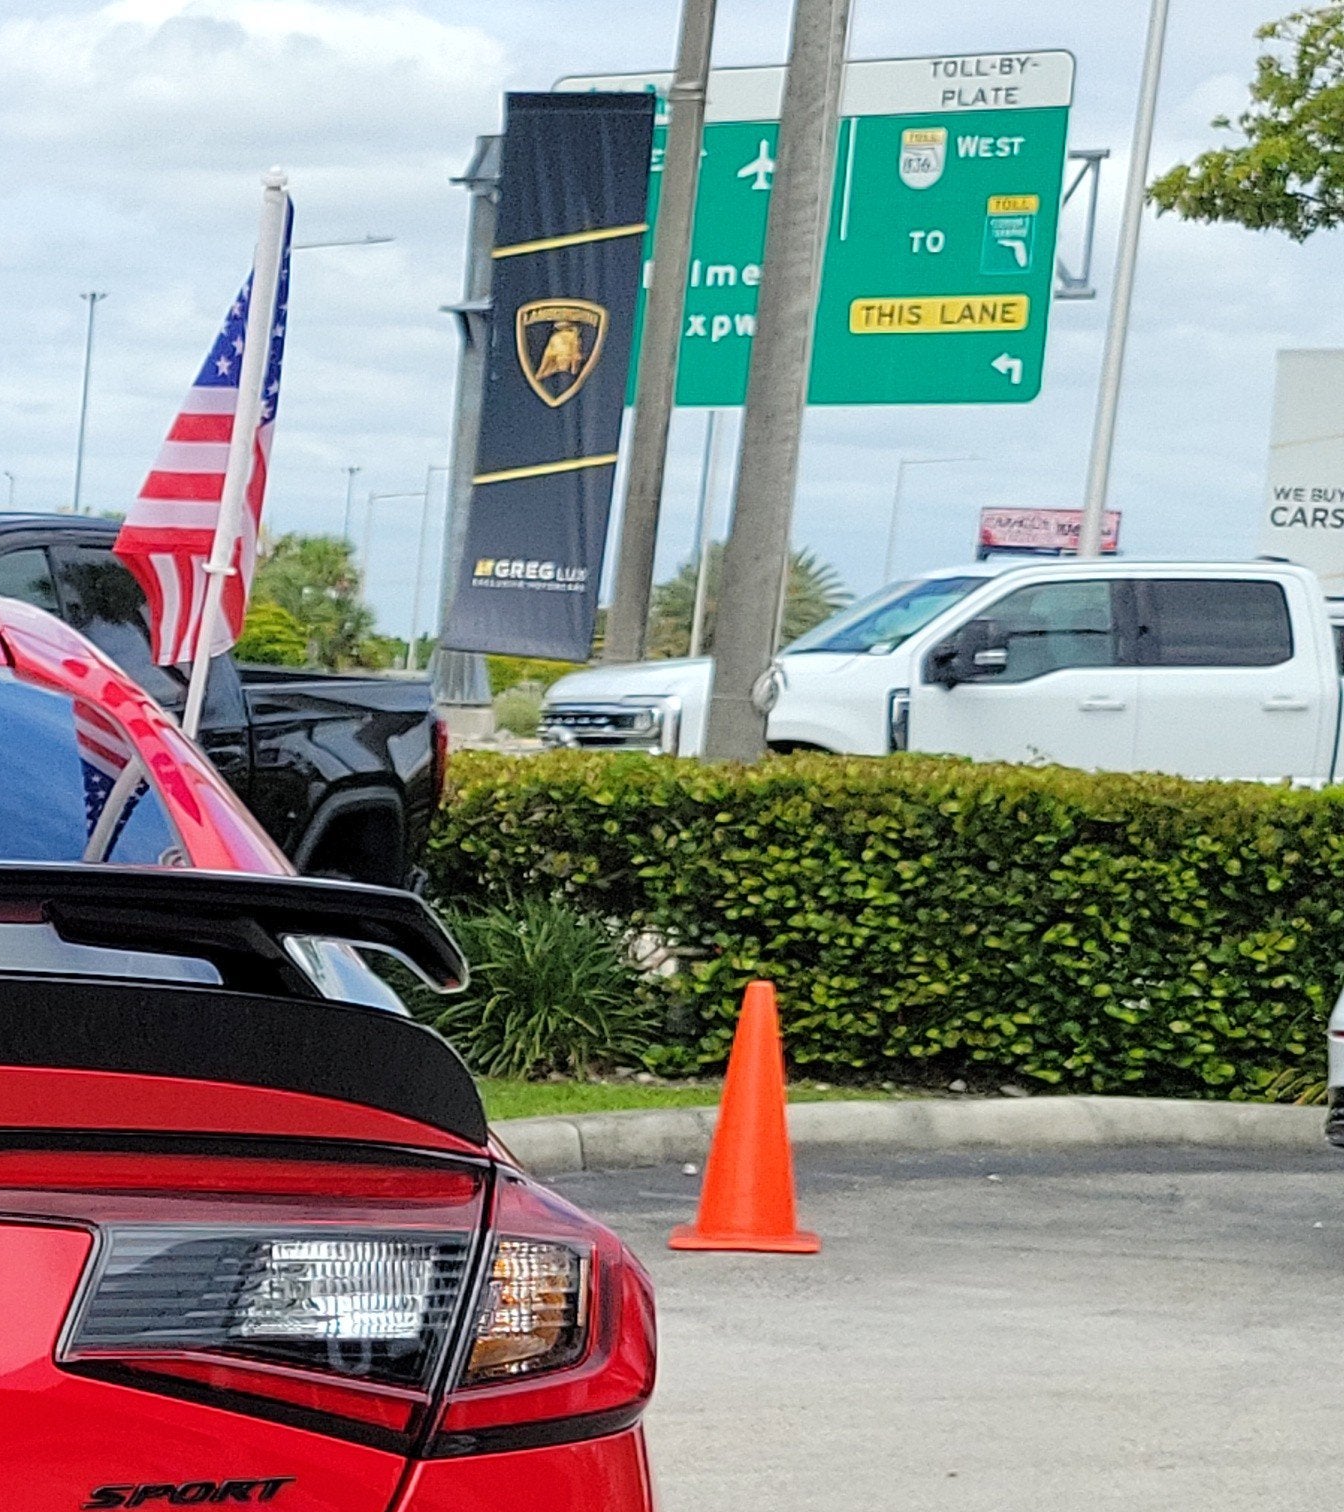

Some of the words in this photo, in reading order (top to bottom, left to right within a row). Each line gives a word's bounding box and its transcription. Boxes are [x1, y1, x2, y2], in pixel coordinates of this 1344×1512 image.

[930, 56, 1040, 78] TOLL-BY-
[941, 86, 1019, 107] PLATE
[956, 134, 1026, 158] WEST
[909, 230, 945, 253] TO
[860, 304, 922, 327] THIS
[940, 302, 1018, 325] LANE
[685, 313, 757, 342] xpw
[1273, 486, 1305, 502] WE
[1270, 506, 1344, 529] CARS
[495, 559, 555, 580] GREG
[80, 1475, 297, 1510] SPORT
